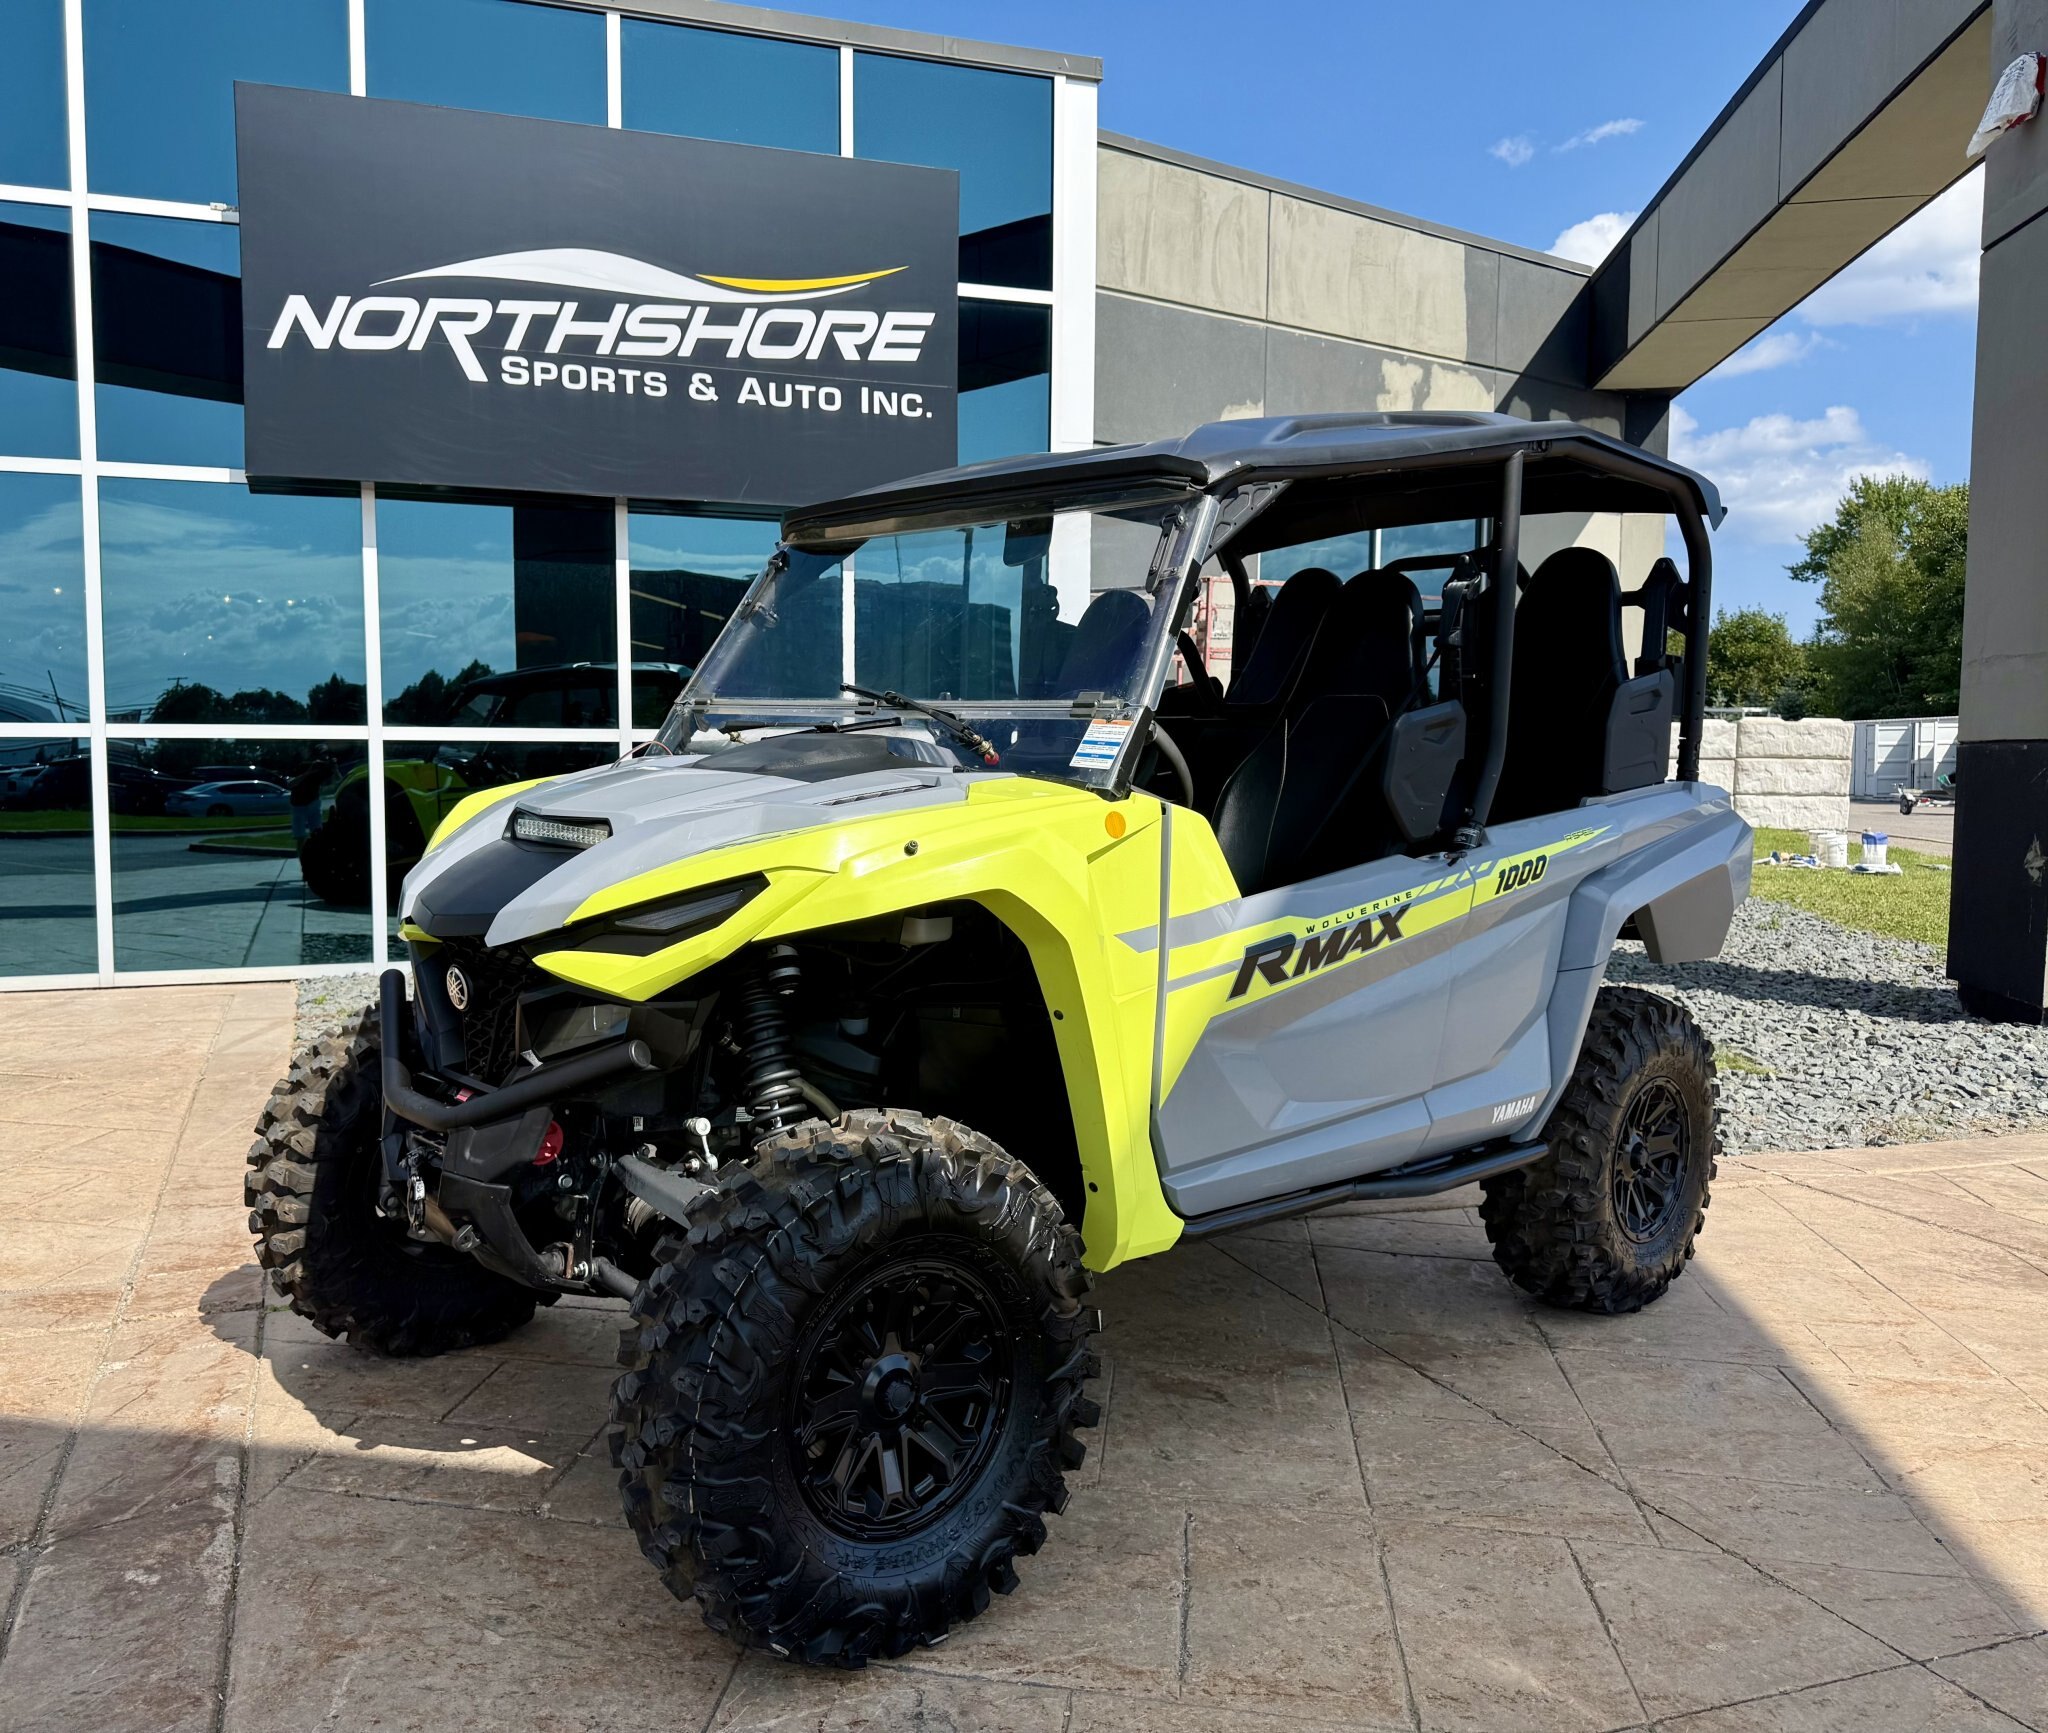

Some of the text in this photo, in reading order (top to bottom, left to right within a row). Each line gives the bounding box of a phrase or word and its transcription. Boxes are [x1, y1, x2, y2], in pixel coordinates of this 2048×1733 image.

[267, 295, 935, 382] NORTHSHORE
[501, 355, 934, 419] SPORTS & AUTO INC.
[1495, 854, 1547, 895] 1000
[1227, 903, 1412, 1002] RMAX
[1491, 1095, 1536, 1124] YAMAHA
